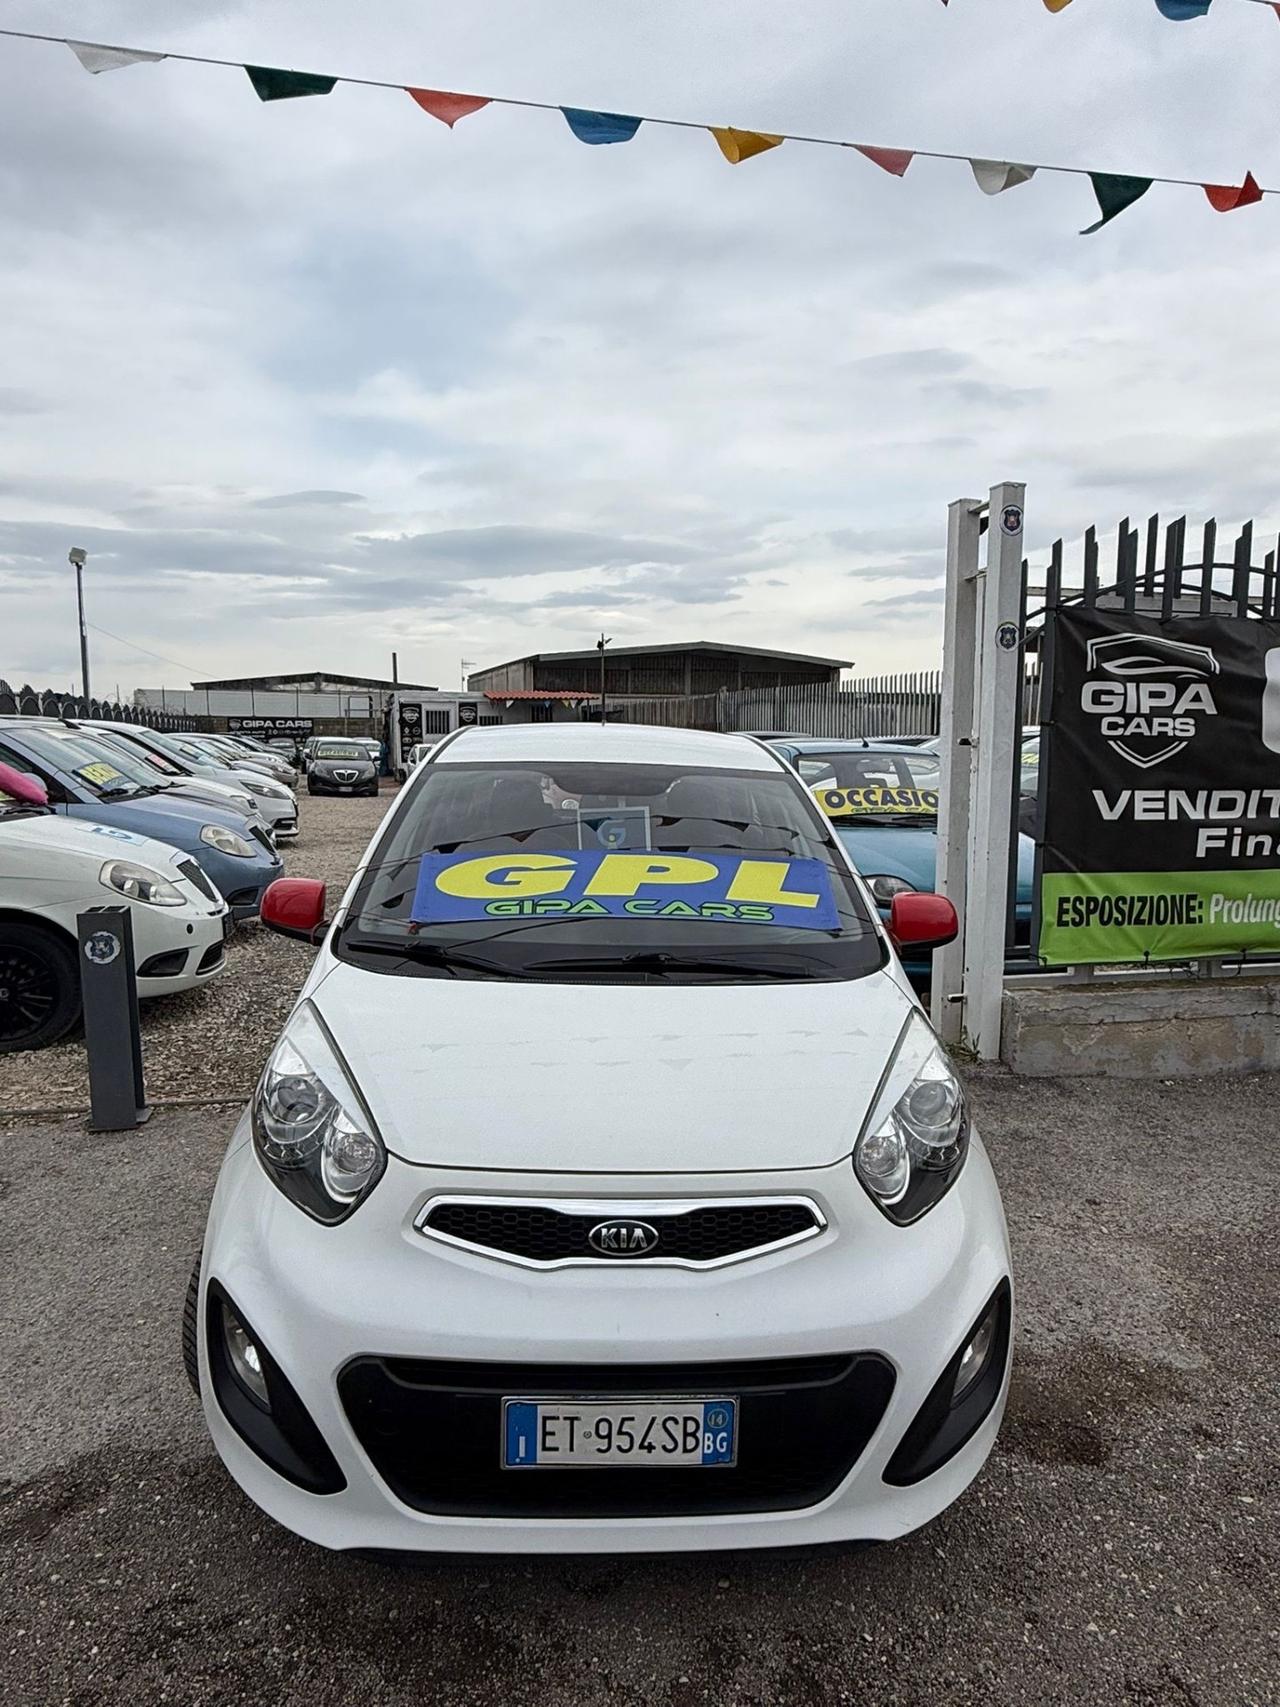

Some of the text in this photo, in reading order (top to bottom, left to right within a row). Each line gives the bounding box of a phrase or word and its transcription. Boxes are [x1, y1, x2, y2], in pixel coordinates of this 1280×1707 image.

[1081, 680, 1218, 715] GIPA
[242, 719, 274, 728] GIPA
[275, 719, 313, 728] CARS
[1100, 716, 1196, 737] CARS
[1091, 789, 1280, 821] VENDIT
[1196, 826, 1280, 858] Fin
[435, 853, 820, 908] GPL
[484, 897, 775, 921] GIPA CARS
[1057, 893, 1204, 928] ESPOSIZIONE:
[601, 1227, 648, 1249] KIA
[541, 1415, 581, 1453] ET
[704, 1431, 728, 1455] BG
